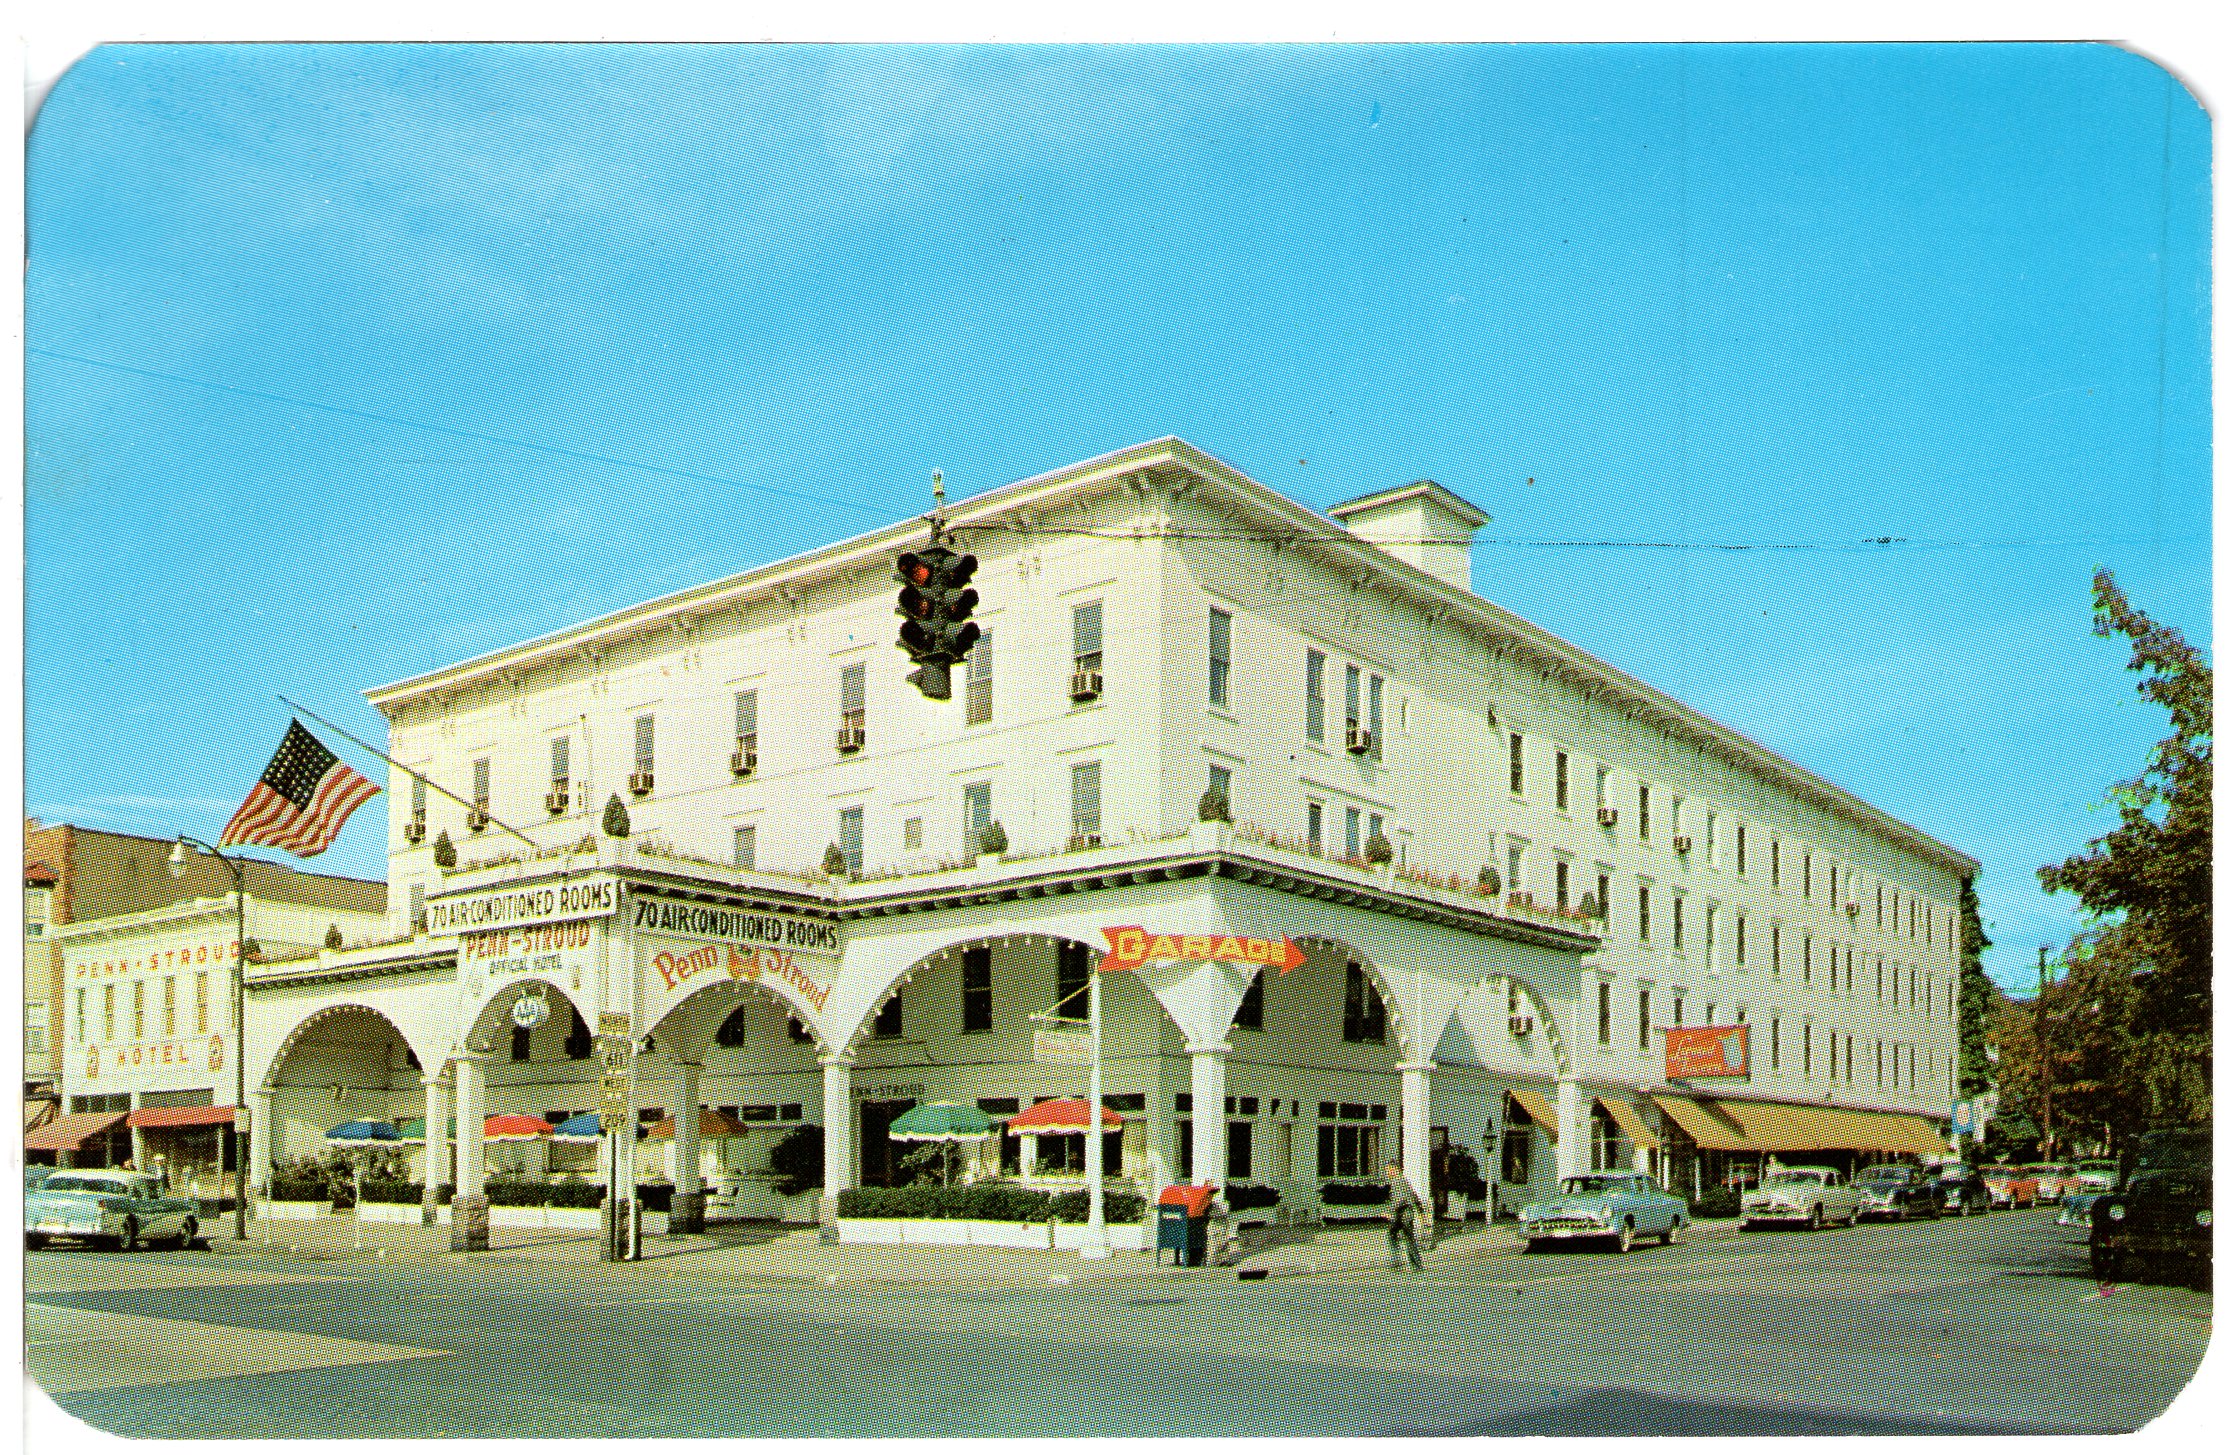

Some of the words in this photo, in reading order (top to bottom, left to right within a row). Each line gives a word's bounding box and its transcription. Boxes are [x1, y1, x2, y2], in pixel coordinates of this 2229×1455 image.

[432, 904, 447, 929] 70
[559, 882, 612, 914] ROOMS
[634, 900, 658, 928] 70
[786, 918, 837, 949] ROOMS
[1117, 928, 1288, 964] GARAGE
[489, 956, 529, 975] OFFICIAL
[533, 953, 563, 970] HOTEL
[654, 944, 718, 991] Penn
[766, 948, 832, 1013] Stroud
[118, 1045, 189, 1067] HOTEL
[606, 1052, 624, 1067] 611
[849, 1083, 926, 1097] ENN-STROUD
[604, 1113, 626, 1128] 209
